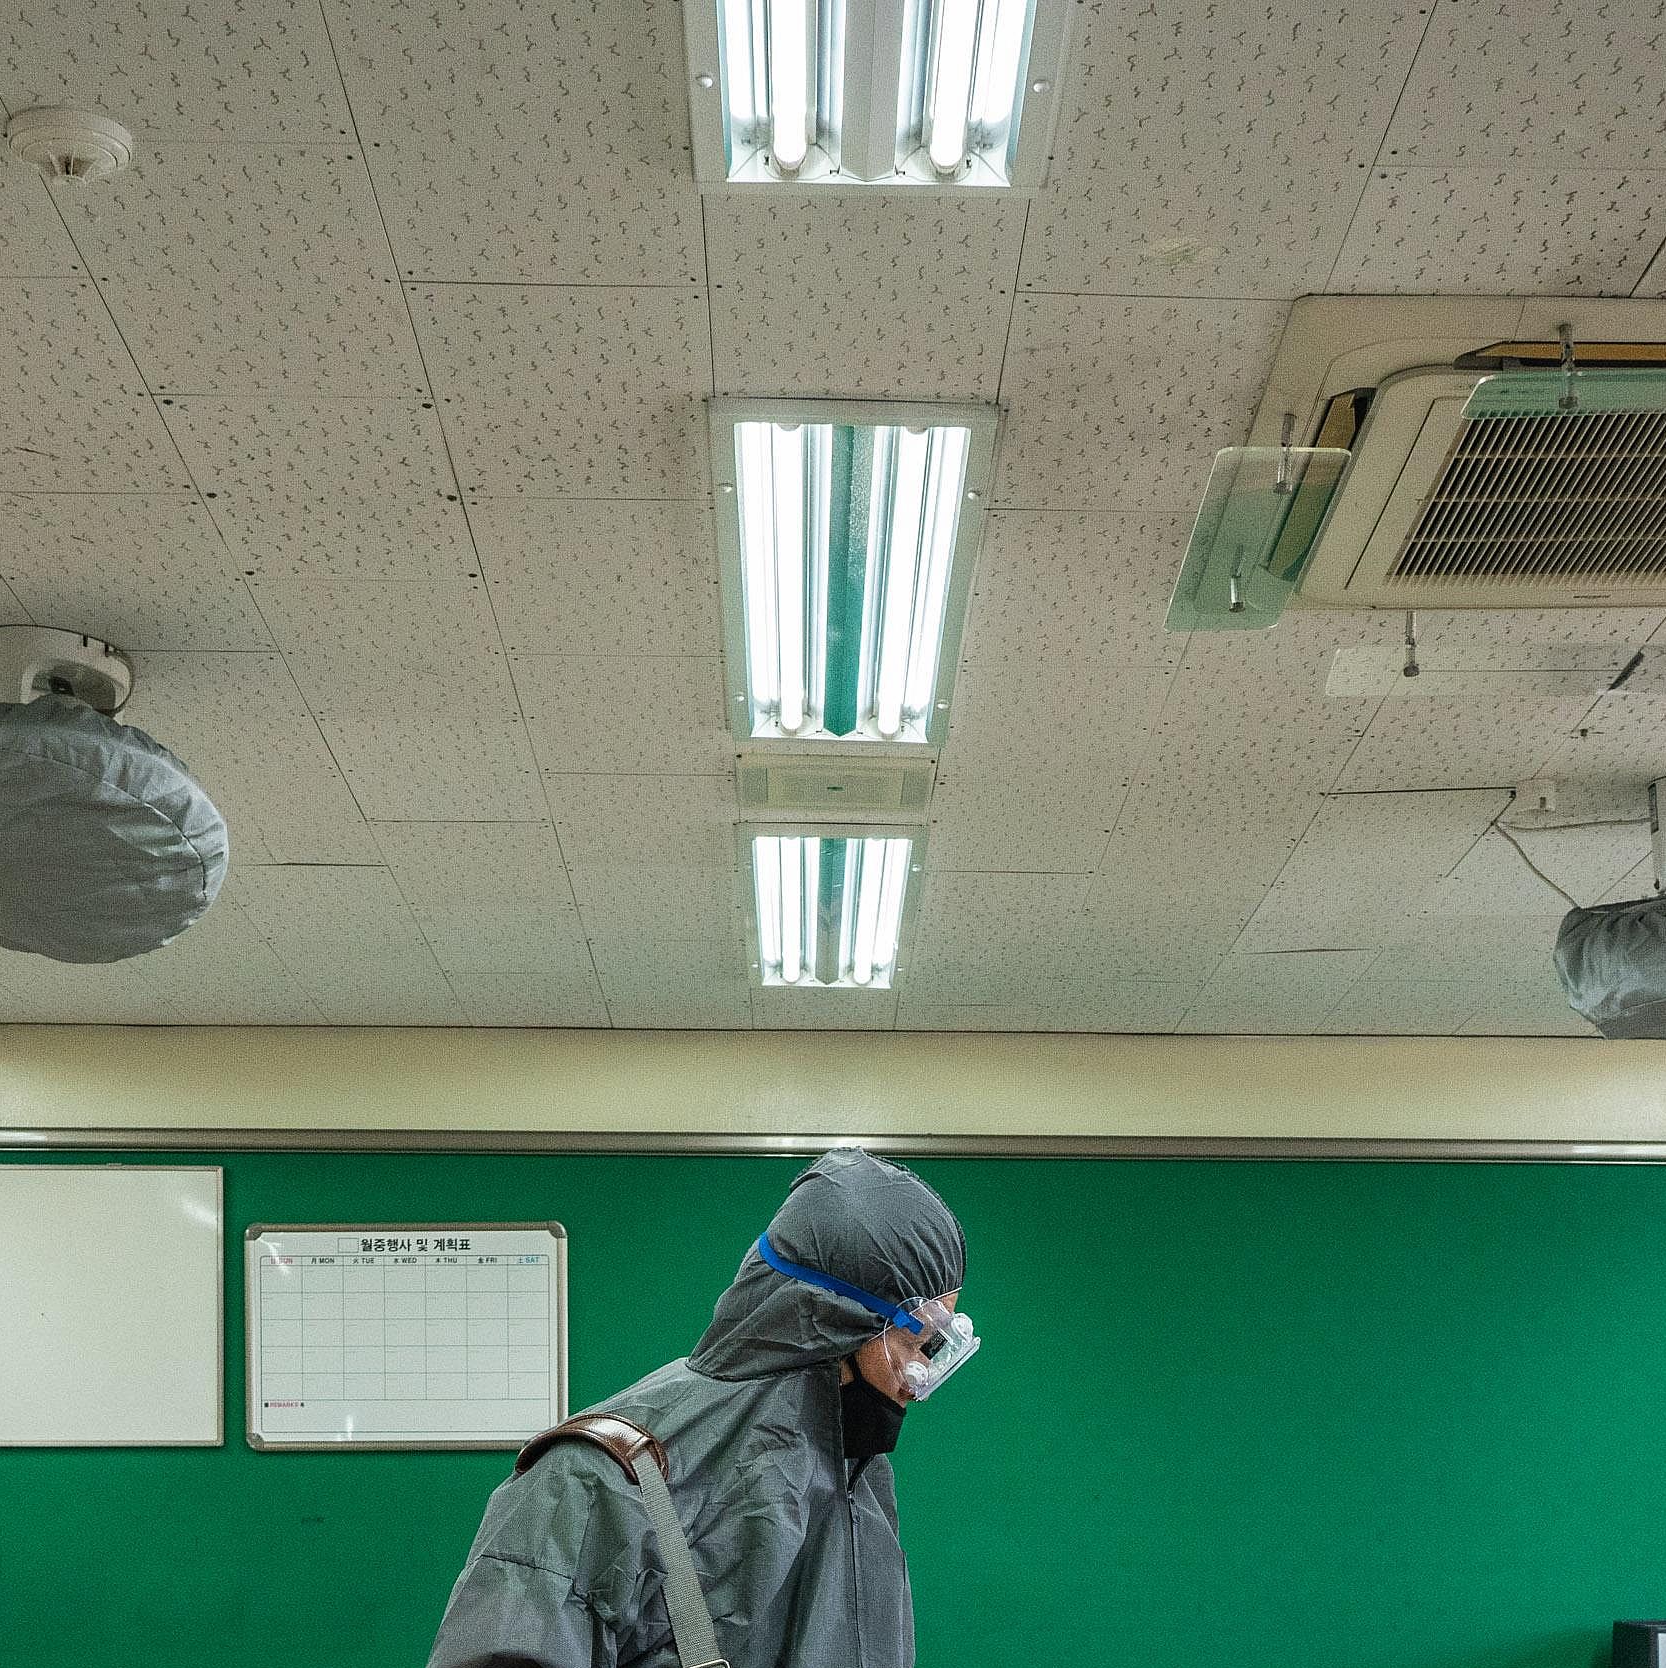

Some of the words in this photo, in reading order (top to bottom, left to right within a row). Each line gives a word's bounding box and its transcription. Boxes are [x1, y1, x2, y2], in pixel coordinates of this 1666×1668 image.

[360, 1238, 411, 1252] 월중행사
[416, 1238, 428, 1252] 및
[433, 1238, 471, 1251] 계획표
